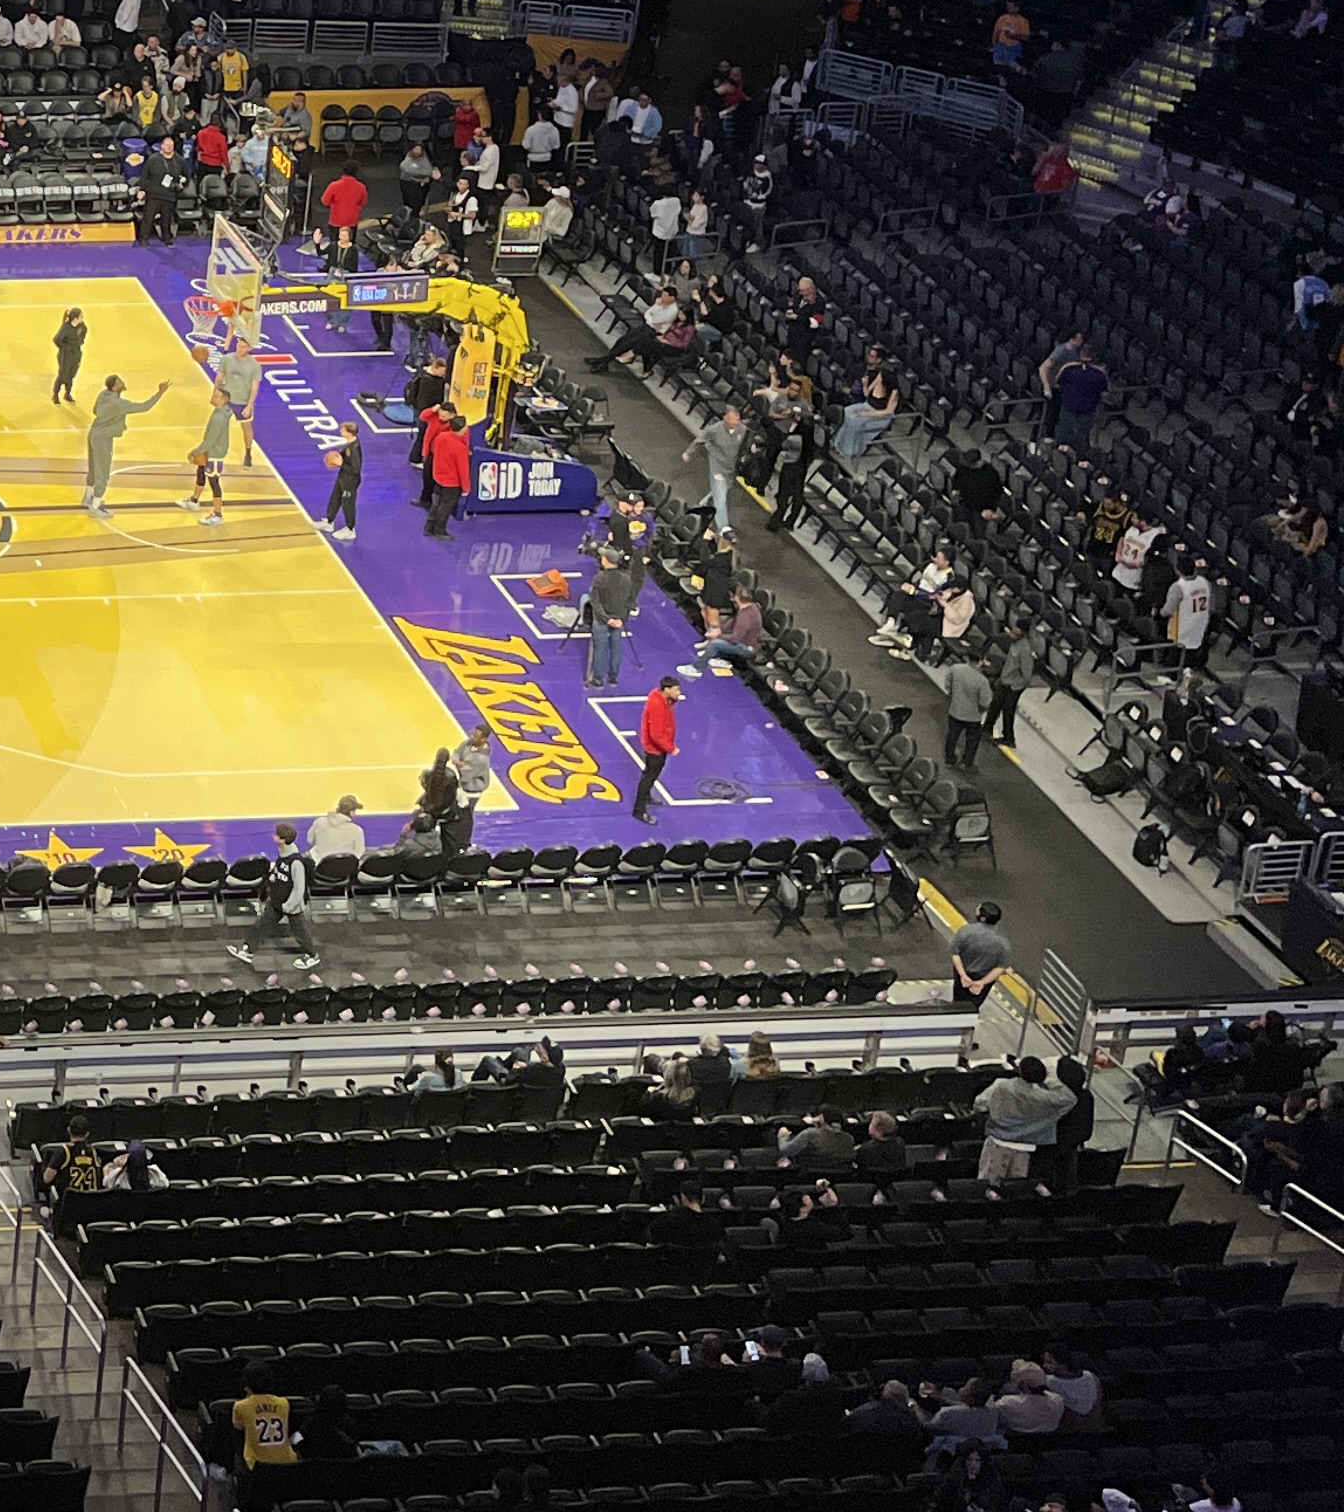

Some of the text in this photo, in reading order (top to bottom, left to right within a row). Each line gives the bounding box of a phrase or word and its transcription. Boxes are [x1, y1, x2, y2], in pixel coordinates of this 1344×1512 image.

[261, 299, 327, 316] AKERS.COM
[264, 369, 348, 450] ULTRA
[498, 461, 524, 500] iD
[528, 461, 555, 479] JOIN
[528, 478, 562, 497] TODAY
[1123, 545, 1140, 560] 24
[1191, 596, 1208, 614] 12
[392, 615, 622, 805] LAKERS
[69, 1166, 98, 1191] 24
[255, 1417, 285, 1443] 23
